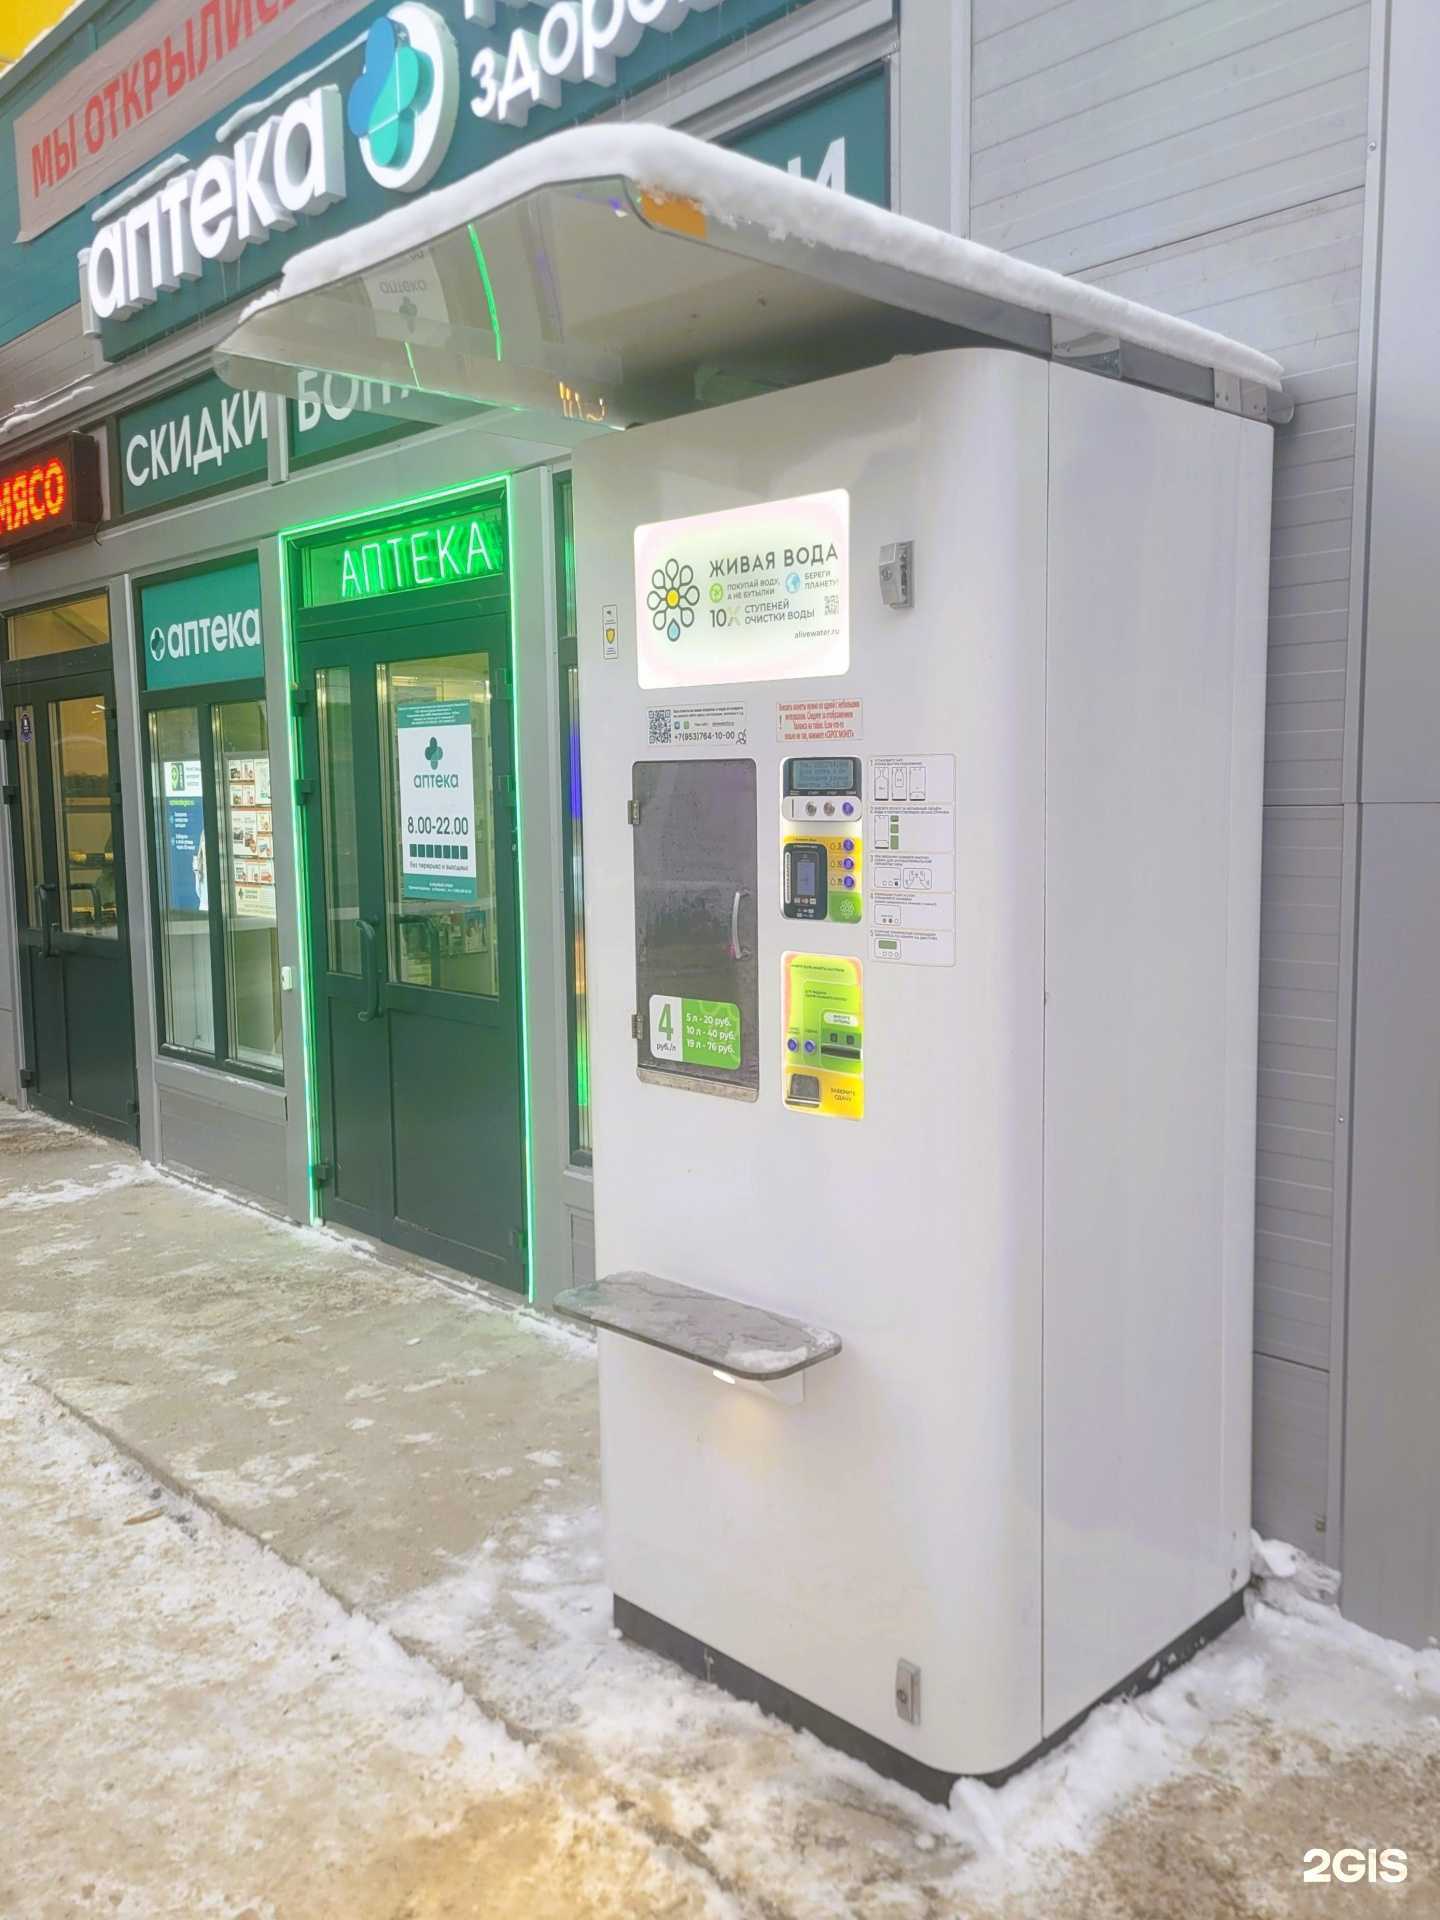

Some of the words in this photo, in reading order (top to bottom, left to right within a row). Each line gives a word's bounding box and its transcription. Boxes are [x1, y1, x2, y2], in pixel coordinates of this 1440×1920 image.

[31, 113, 77, 198] МЫ
[83, 0, 297, 153] ОТКРЫЛИ
[88, 83, 346, 322] аптека
[126, 388, 268, 487] СКИДКИ
[341, 521, 493, 598] АПТЕКА
[709, 551, 775, 578] ЖИВАЯ
[783, 544, 838, 567] ВОДА
[804, 570, 831, 580] БЕРЕГИ
[727, 580, 759, 591] ПОКУПАЙ
[733, 592, 742, 600] НЕ
[743, 588, 775, 599] БУТЫЛКИ
[744, 598, 790, 614] СТУПЕНЕЙ
[744, 612, 786, 625] ОЧИСТКИ
[787, 608, 815, 620] ВОДЫ
[167, 608, 260, 659] аптека
[413, 773, 459, 788] аптека
[407, 816, 469, 835] 8.00-22.00
[658, 1003, 674, 1041] 4
[703, 1015, 713, 1024] 20
[714, 1016, 731, 1027] руб.
[687, 1026, 695, 1034] 10
[706, 1029, 717, 1038] 40
[719, 1031, 735, 1041] руб.
[718, 1044, 735, 1055] руб.
